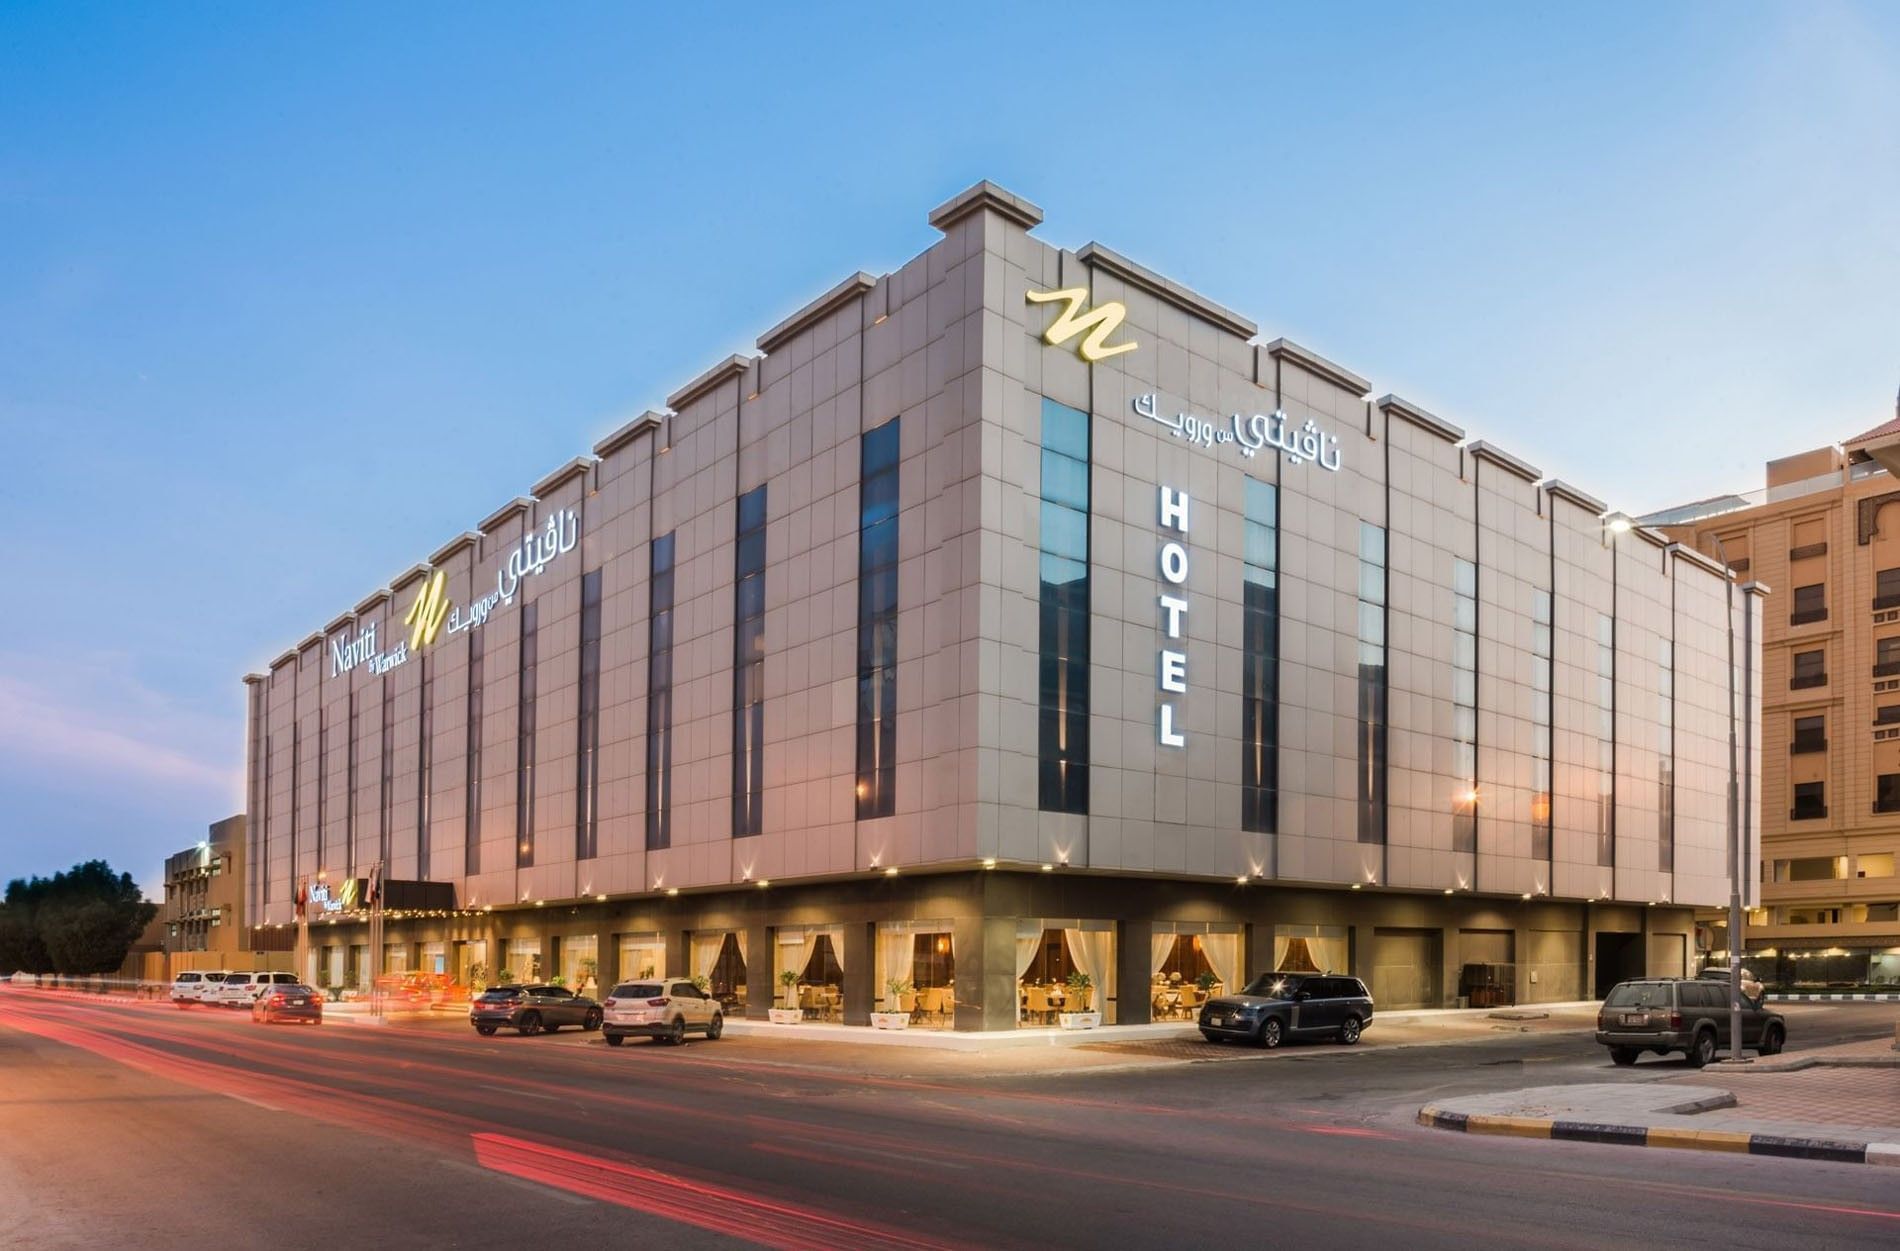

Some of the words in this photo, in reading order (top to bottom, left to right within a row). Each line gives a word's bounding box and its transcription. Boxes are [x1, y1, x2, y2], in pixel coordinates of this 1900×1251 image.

[1216, 429, 1234, 444] من
[1160, 485, 1189, 747] HOTEL
[332, 621, 376, 678] Naviti
[375, 641, 407, 676] Warwick
